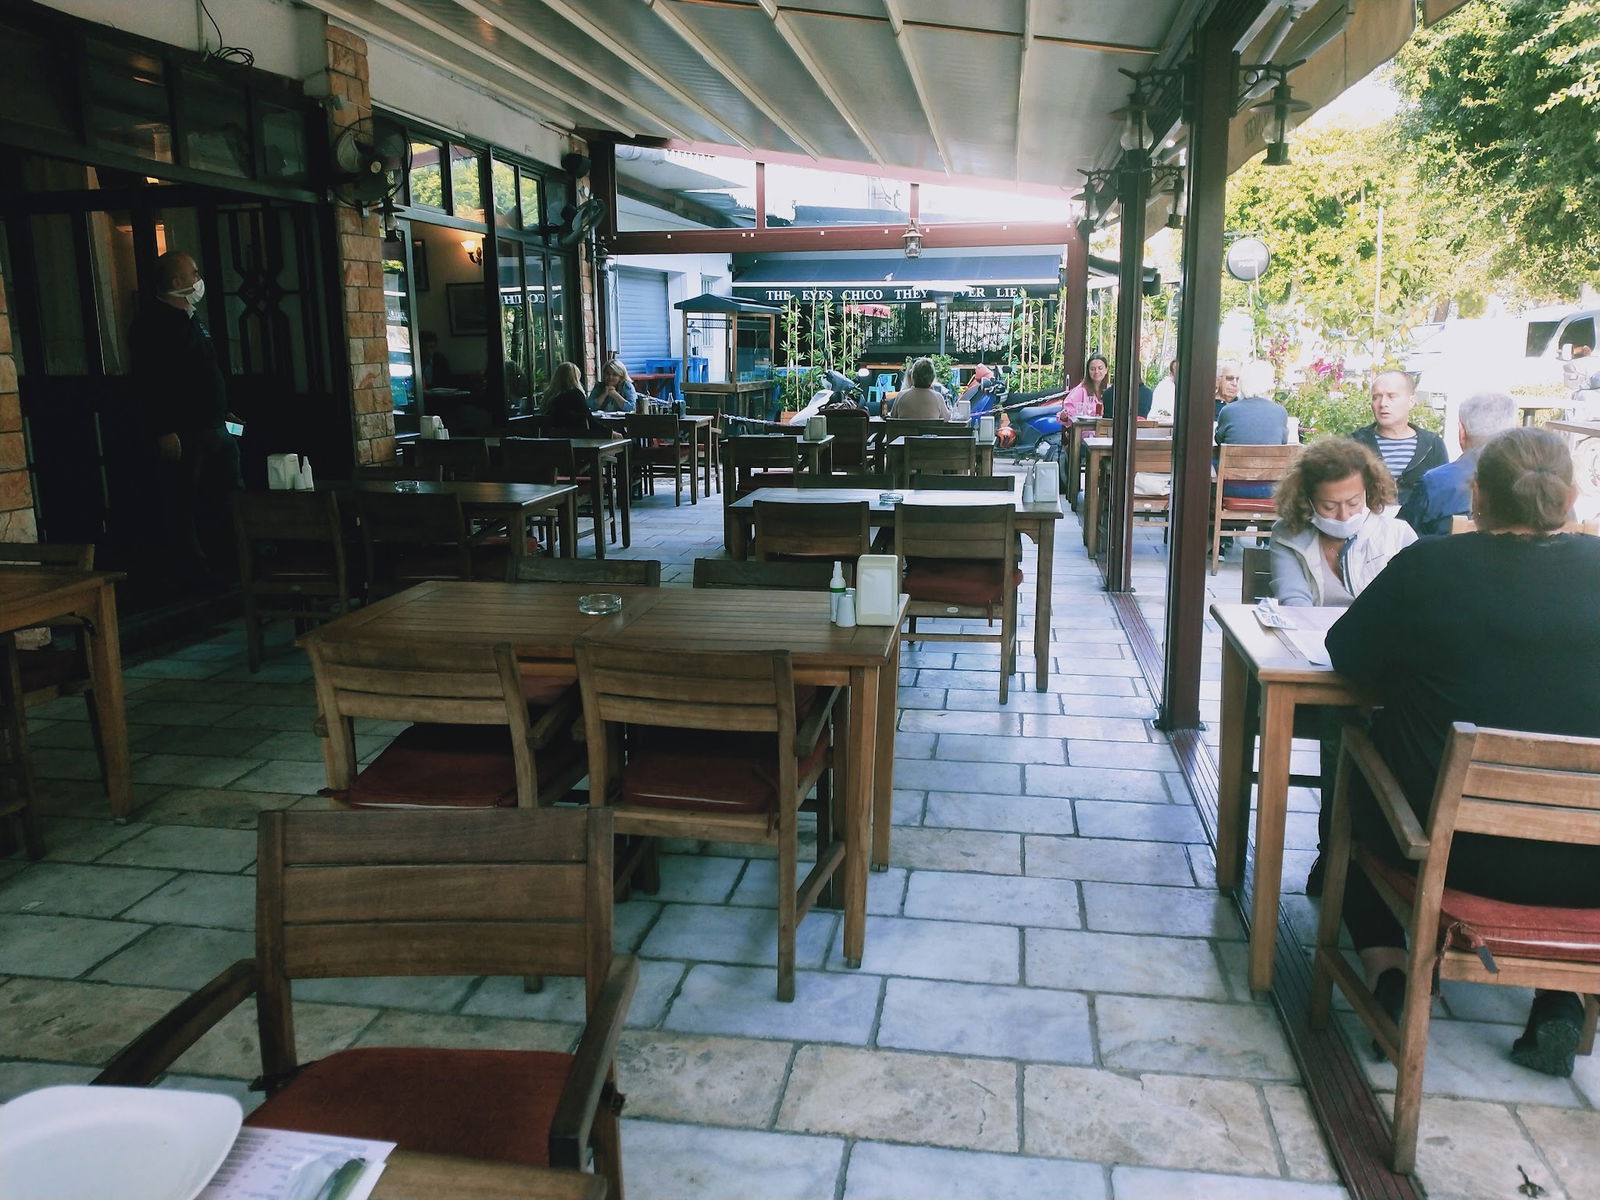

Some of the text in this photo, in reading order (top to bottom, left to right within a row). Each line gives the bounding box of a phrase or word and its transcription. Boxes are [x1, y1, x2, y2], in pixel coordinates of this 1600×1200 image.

[766, 290, 791, 300] THE
[802, 290, 833, 300] EYES
[842, 290, 883, 300] CHICO
[894, 289, 928, 299] THEY
[996, 288, 1018, 297] LIE
